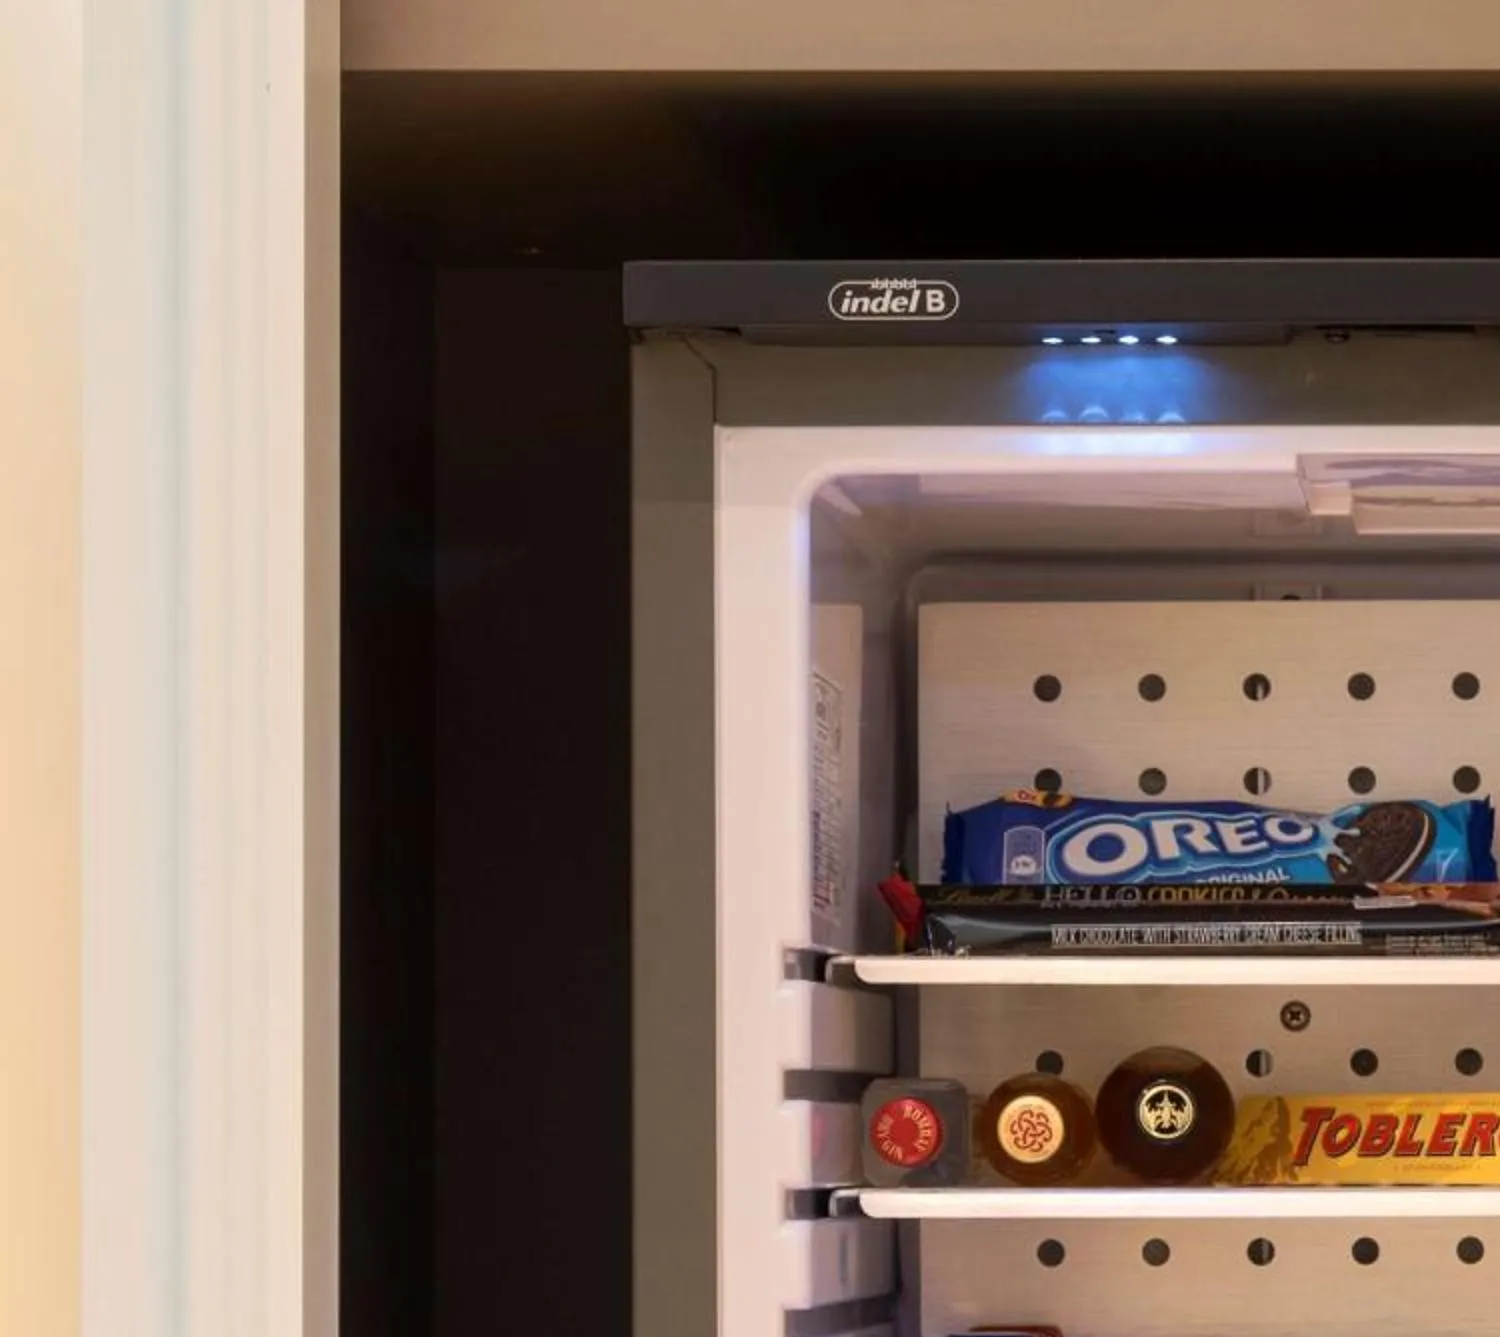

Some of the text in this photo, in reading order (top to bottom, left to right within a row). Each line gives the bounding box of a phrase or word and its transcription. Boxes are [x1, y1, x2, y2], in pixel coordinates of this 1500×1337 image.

[841, 289, 945, 313] indel B
[1063, 818, 1313, 876] OREO
[1197, 868, 1290, 885] RIGINAL
